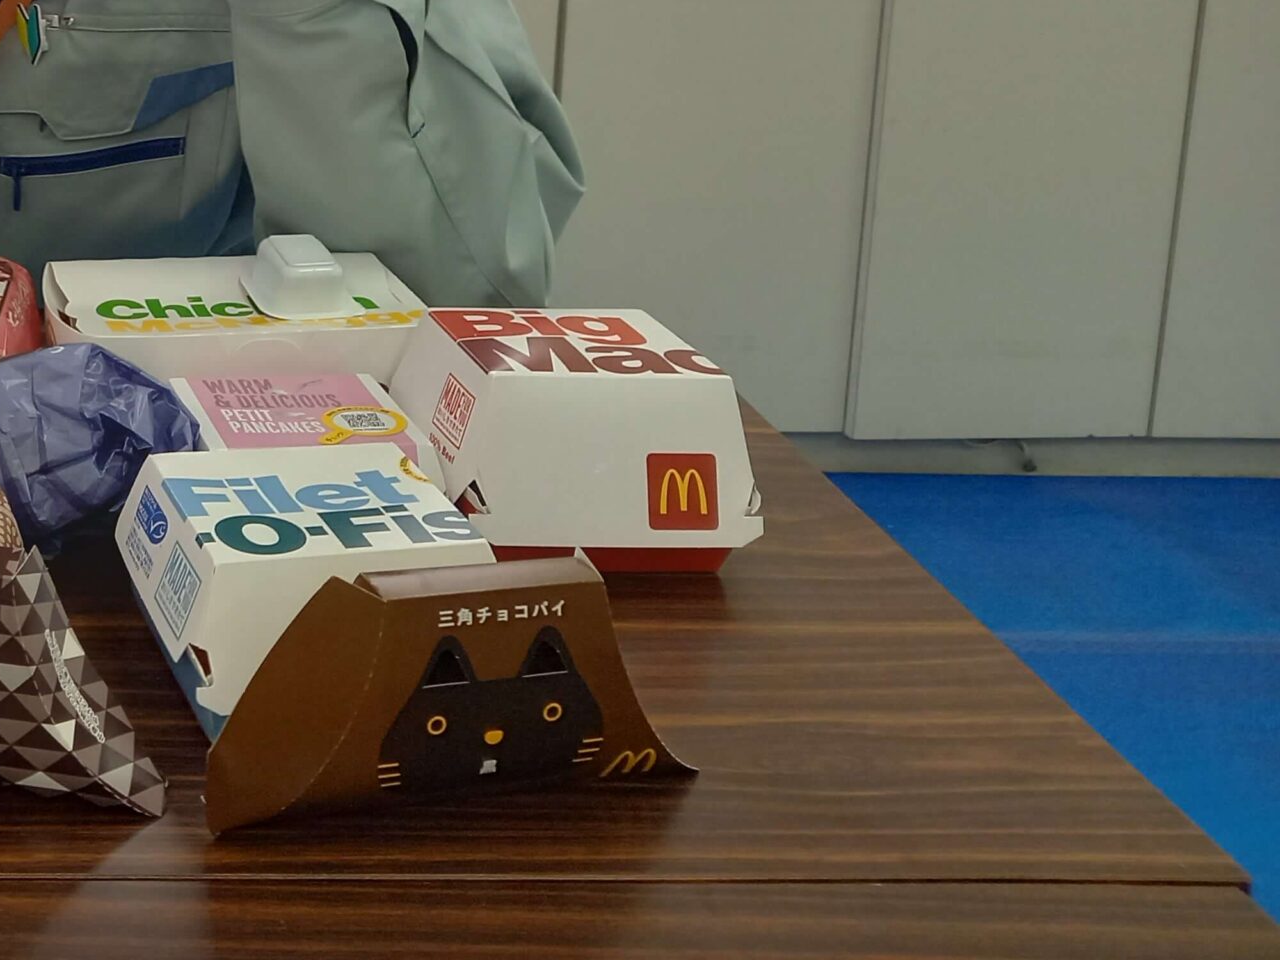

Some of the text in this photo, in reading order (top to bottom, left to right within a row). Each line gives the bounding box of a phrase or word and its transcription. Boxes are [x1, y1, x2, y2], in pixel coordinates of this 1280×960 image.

[428, 309, 648, 346] Big
[457, 336, 728, 376] Mac
[202, 378, 273, 395] WARM
[214, 393, 342, 409] & DELICIOUS
[220, 408, 273, 423] PETIT
[229, 419, 326, 434] PANCAKES
[161, 469, 420, 521] Filet
[437, 599, 566, 629] 三角チョコパイ
